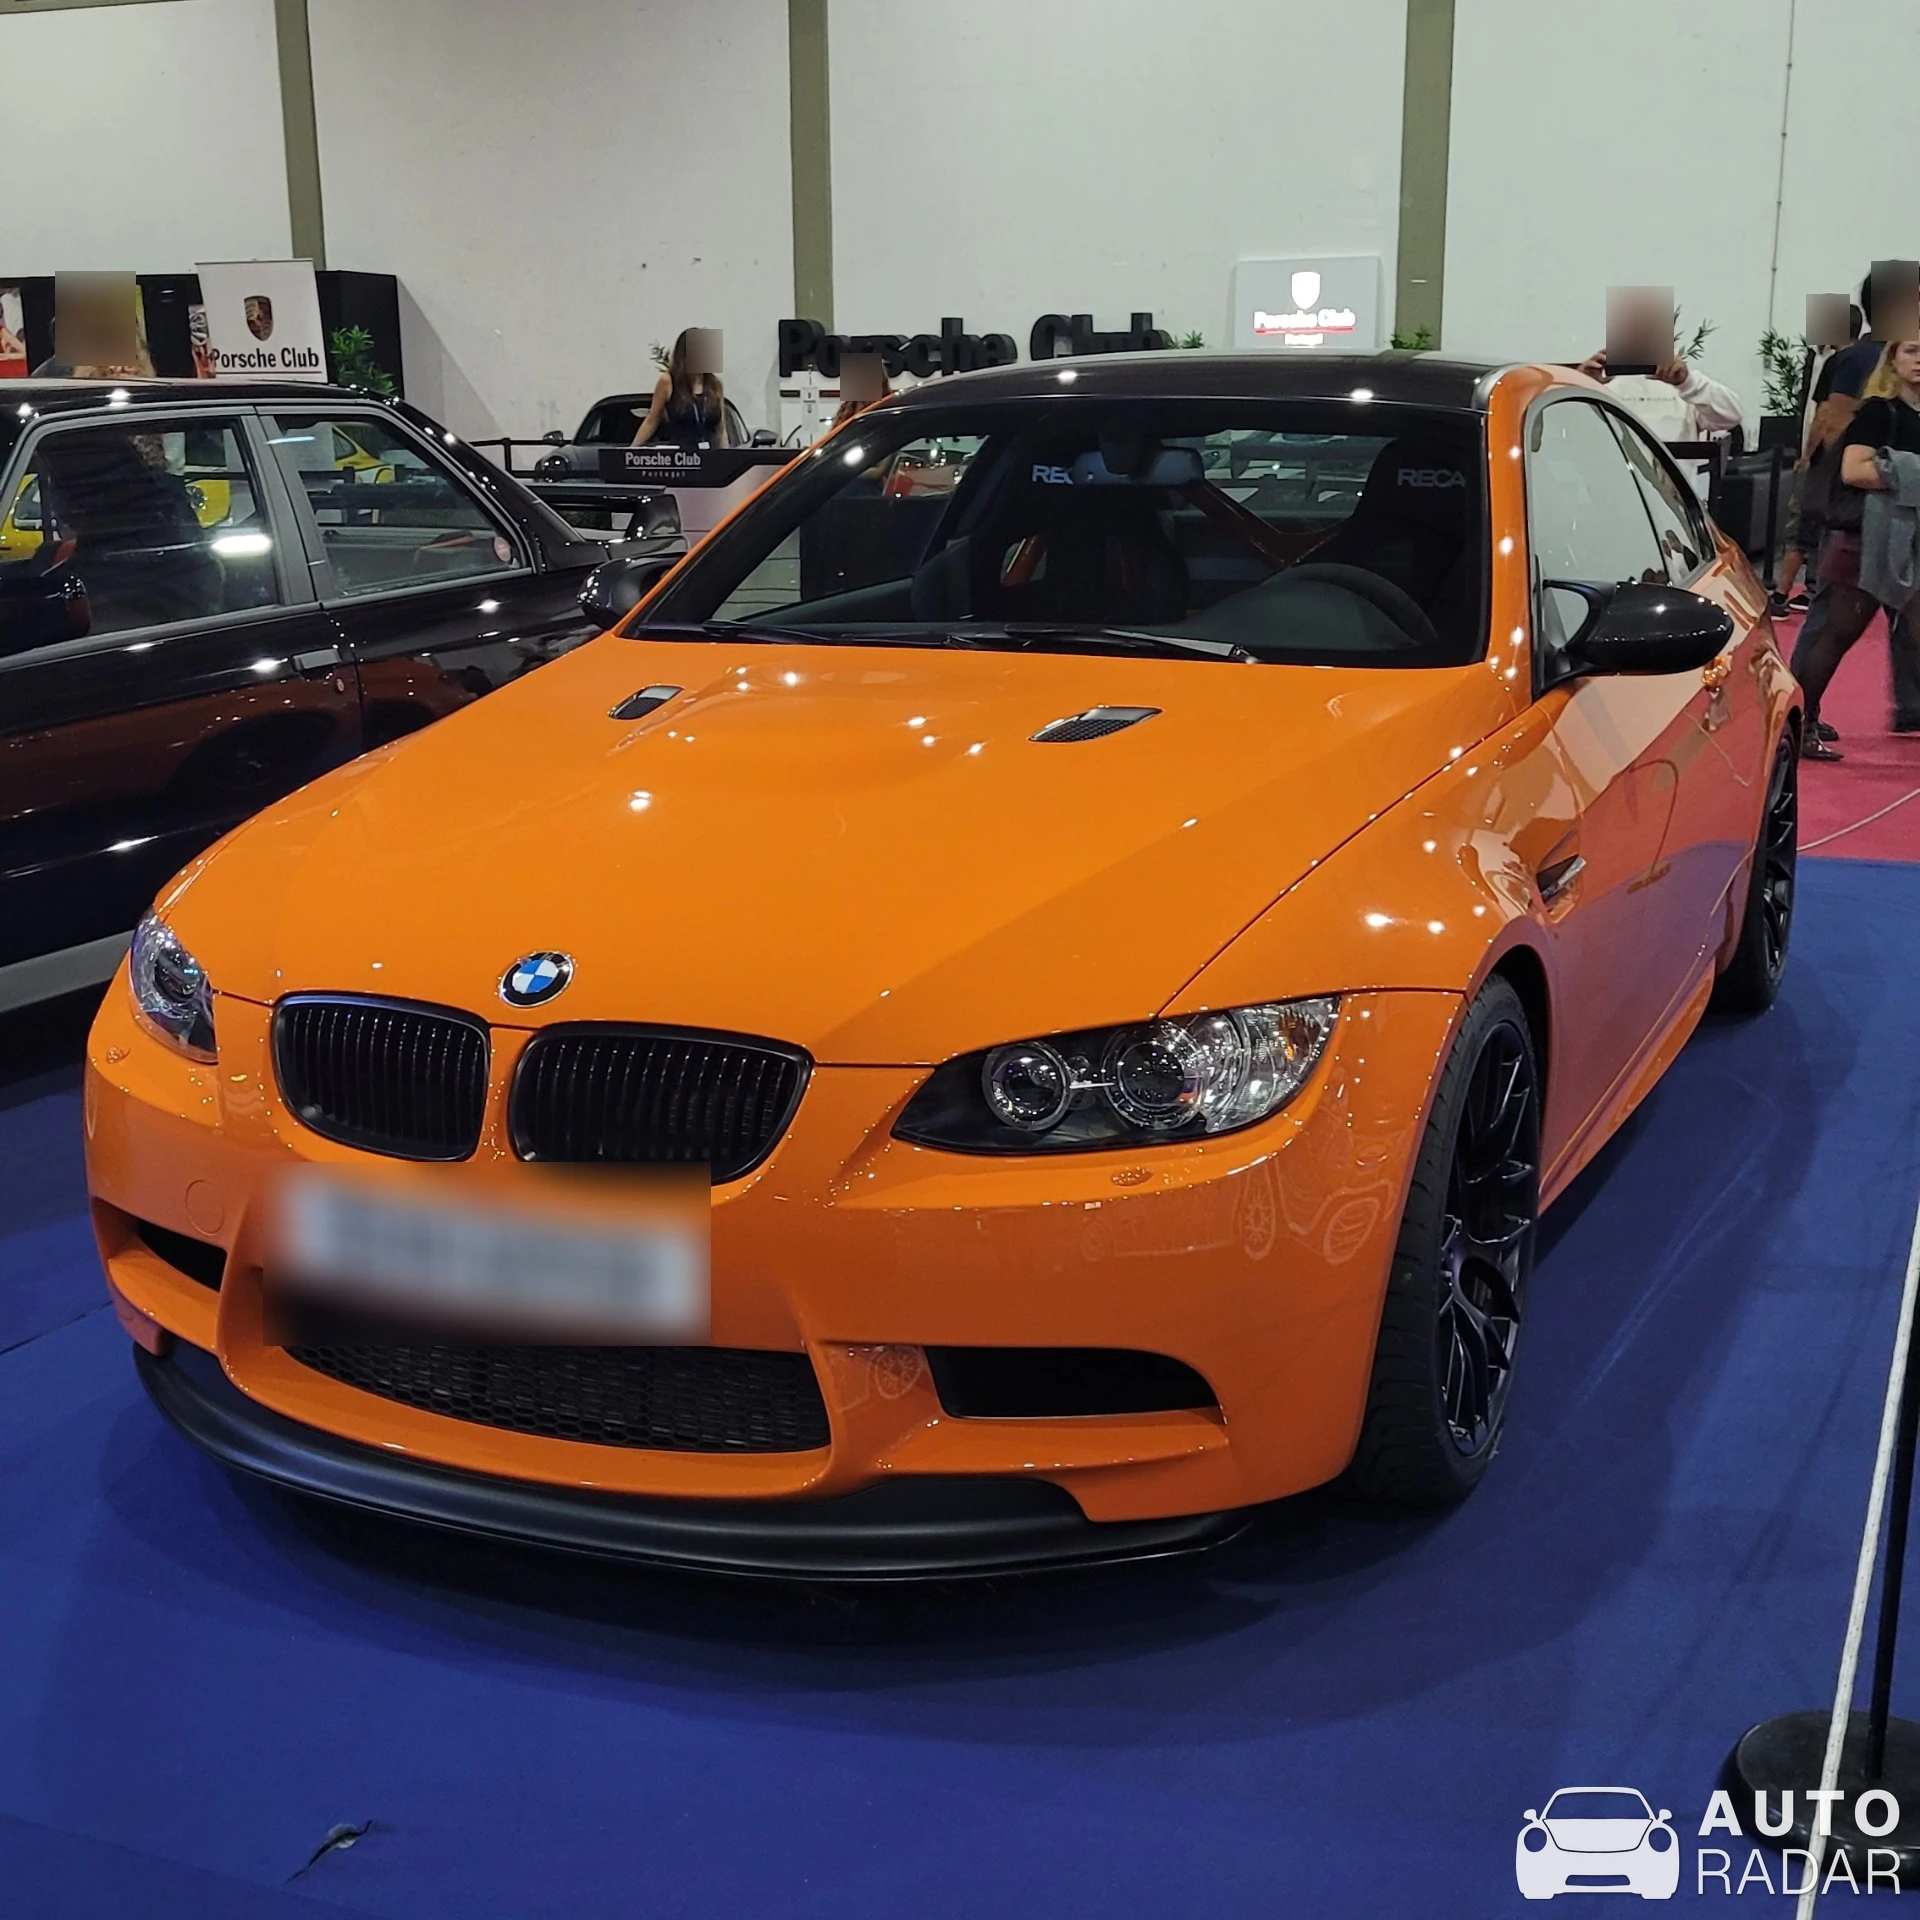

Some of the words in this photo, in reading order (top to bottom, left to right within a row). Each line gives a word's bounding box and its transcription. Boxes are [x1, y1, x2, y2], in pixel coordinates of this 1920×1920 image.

[210, 347, 277, 369] Porsche
[281, 347, 320, 368] Club
[625, 452, 671, 466] Porsche
[674, 452, 701, 466] Club
